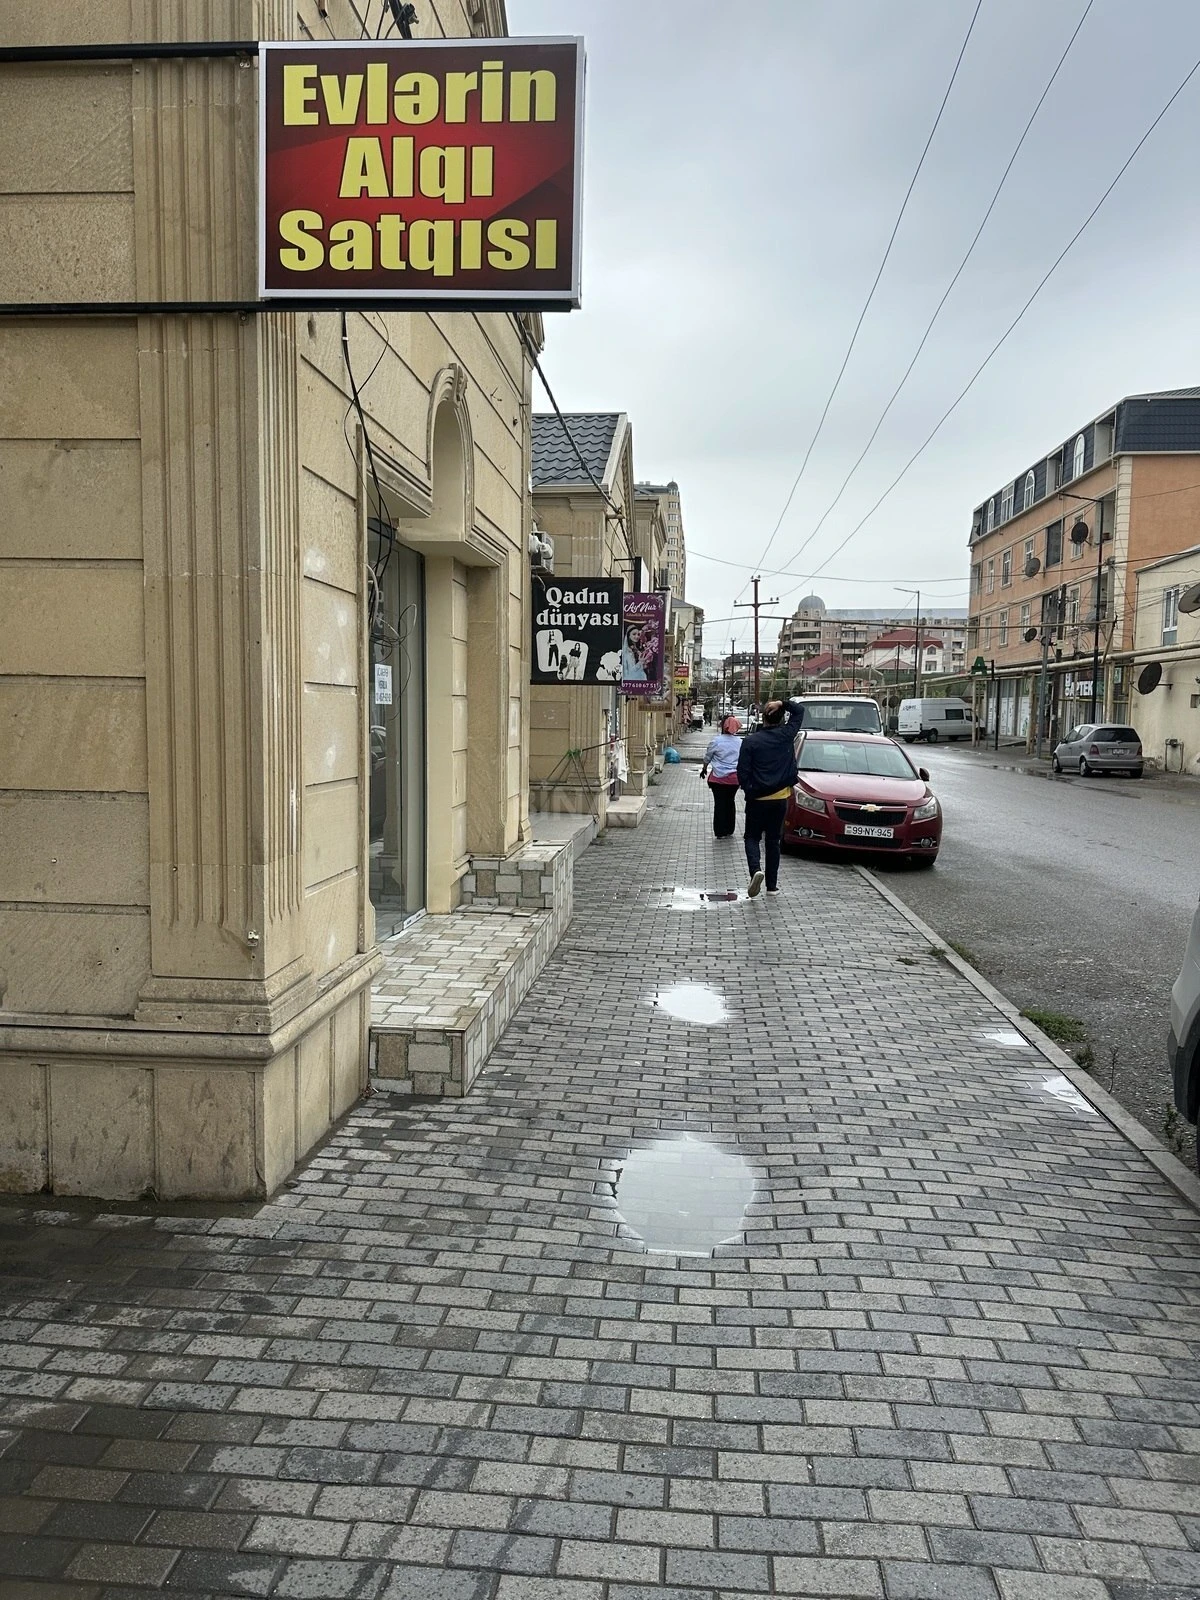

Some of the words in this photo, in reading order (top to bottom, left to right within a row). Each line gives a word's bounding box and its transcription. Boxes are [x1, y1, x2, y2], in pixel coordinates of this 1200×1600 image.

[283, 61, 557, 126] Evlərin
[338, 136, 494, 204] Alqı
[278, 209, 557, 277] Satqısı
[536, 608, 619, 630] dünyası
[546, 587, 610, 608] Qadın
[852, 826, 892, 838] 99-NY-945
